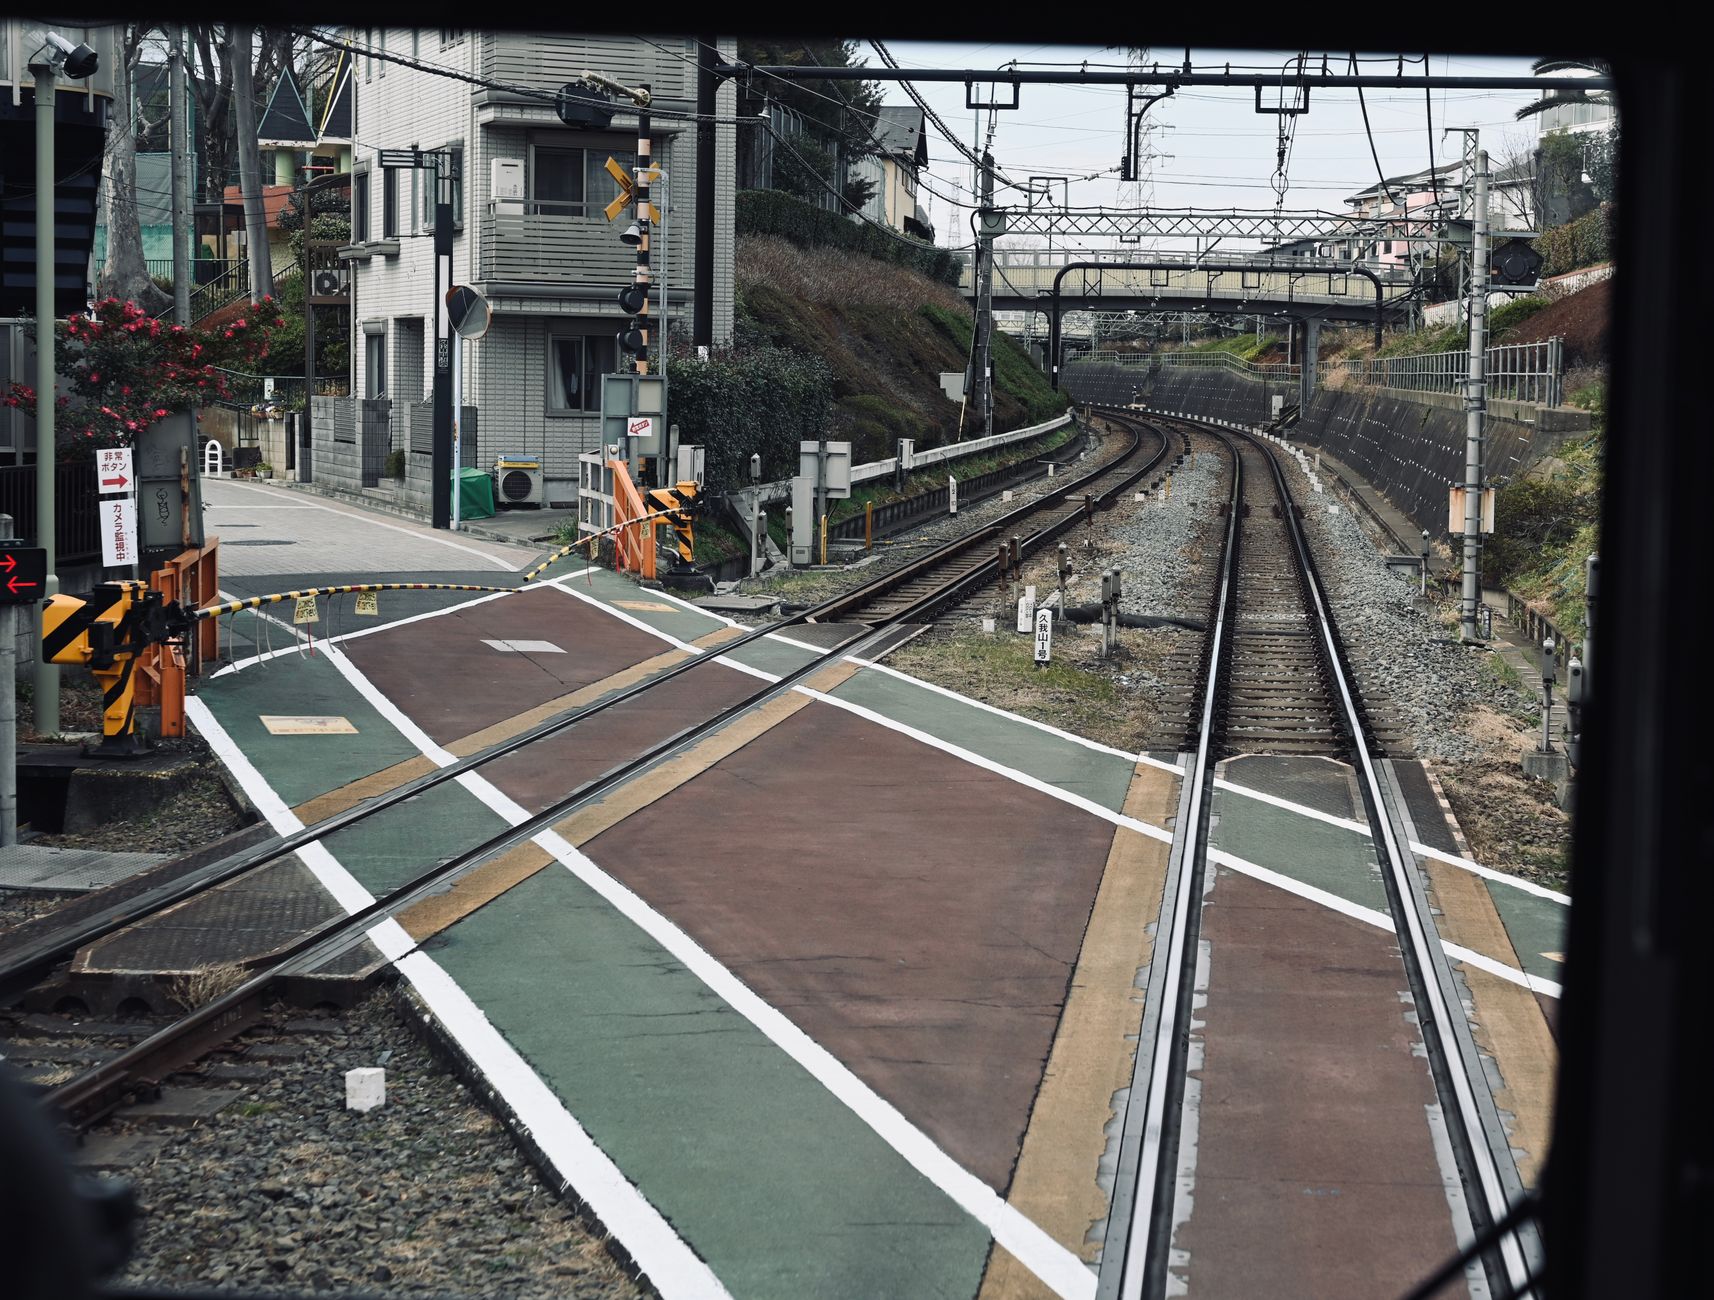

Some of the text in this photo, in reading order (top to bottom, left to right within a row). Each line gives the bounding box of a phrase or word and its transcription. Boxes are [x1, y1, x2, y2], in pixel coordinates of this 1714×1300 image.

[101, 462, 127, 472] ボタン
[104, 451, 123, 462] 非常
[113, 503, 126, 562] カメラ監視中
[1037, 614, 1048, 659] 久我山1号
